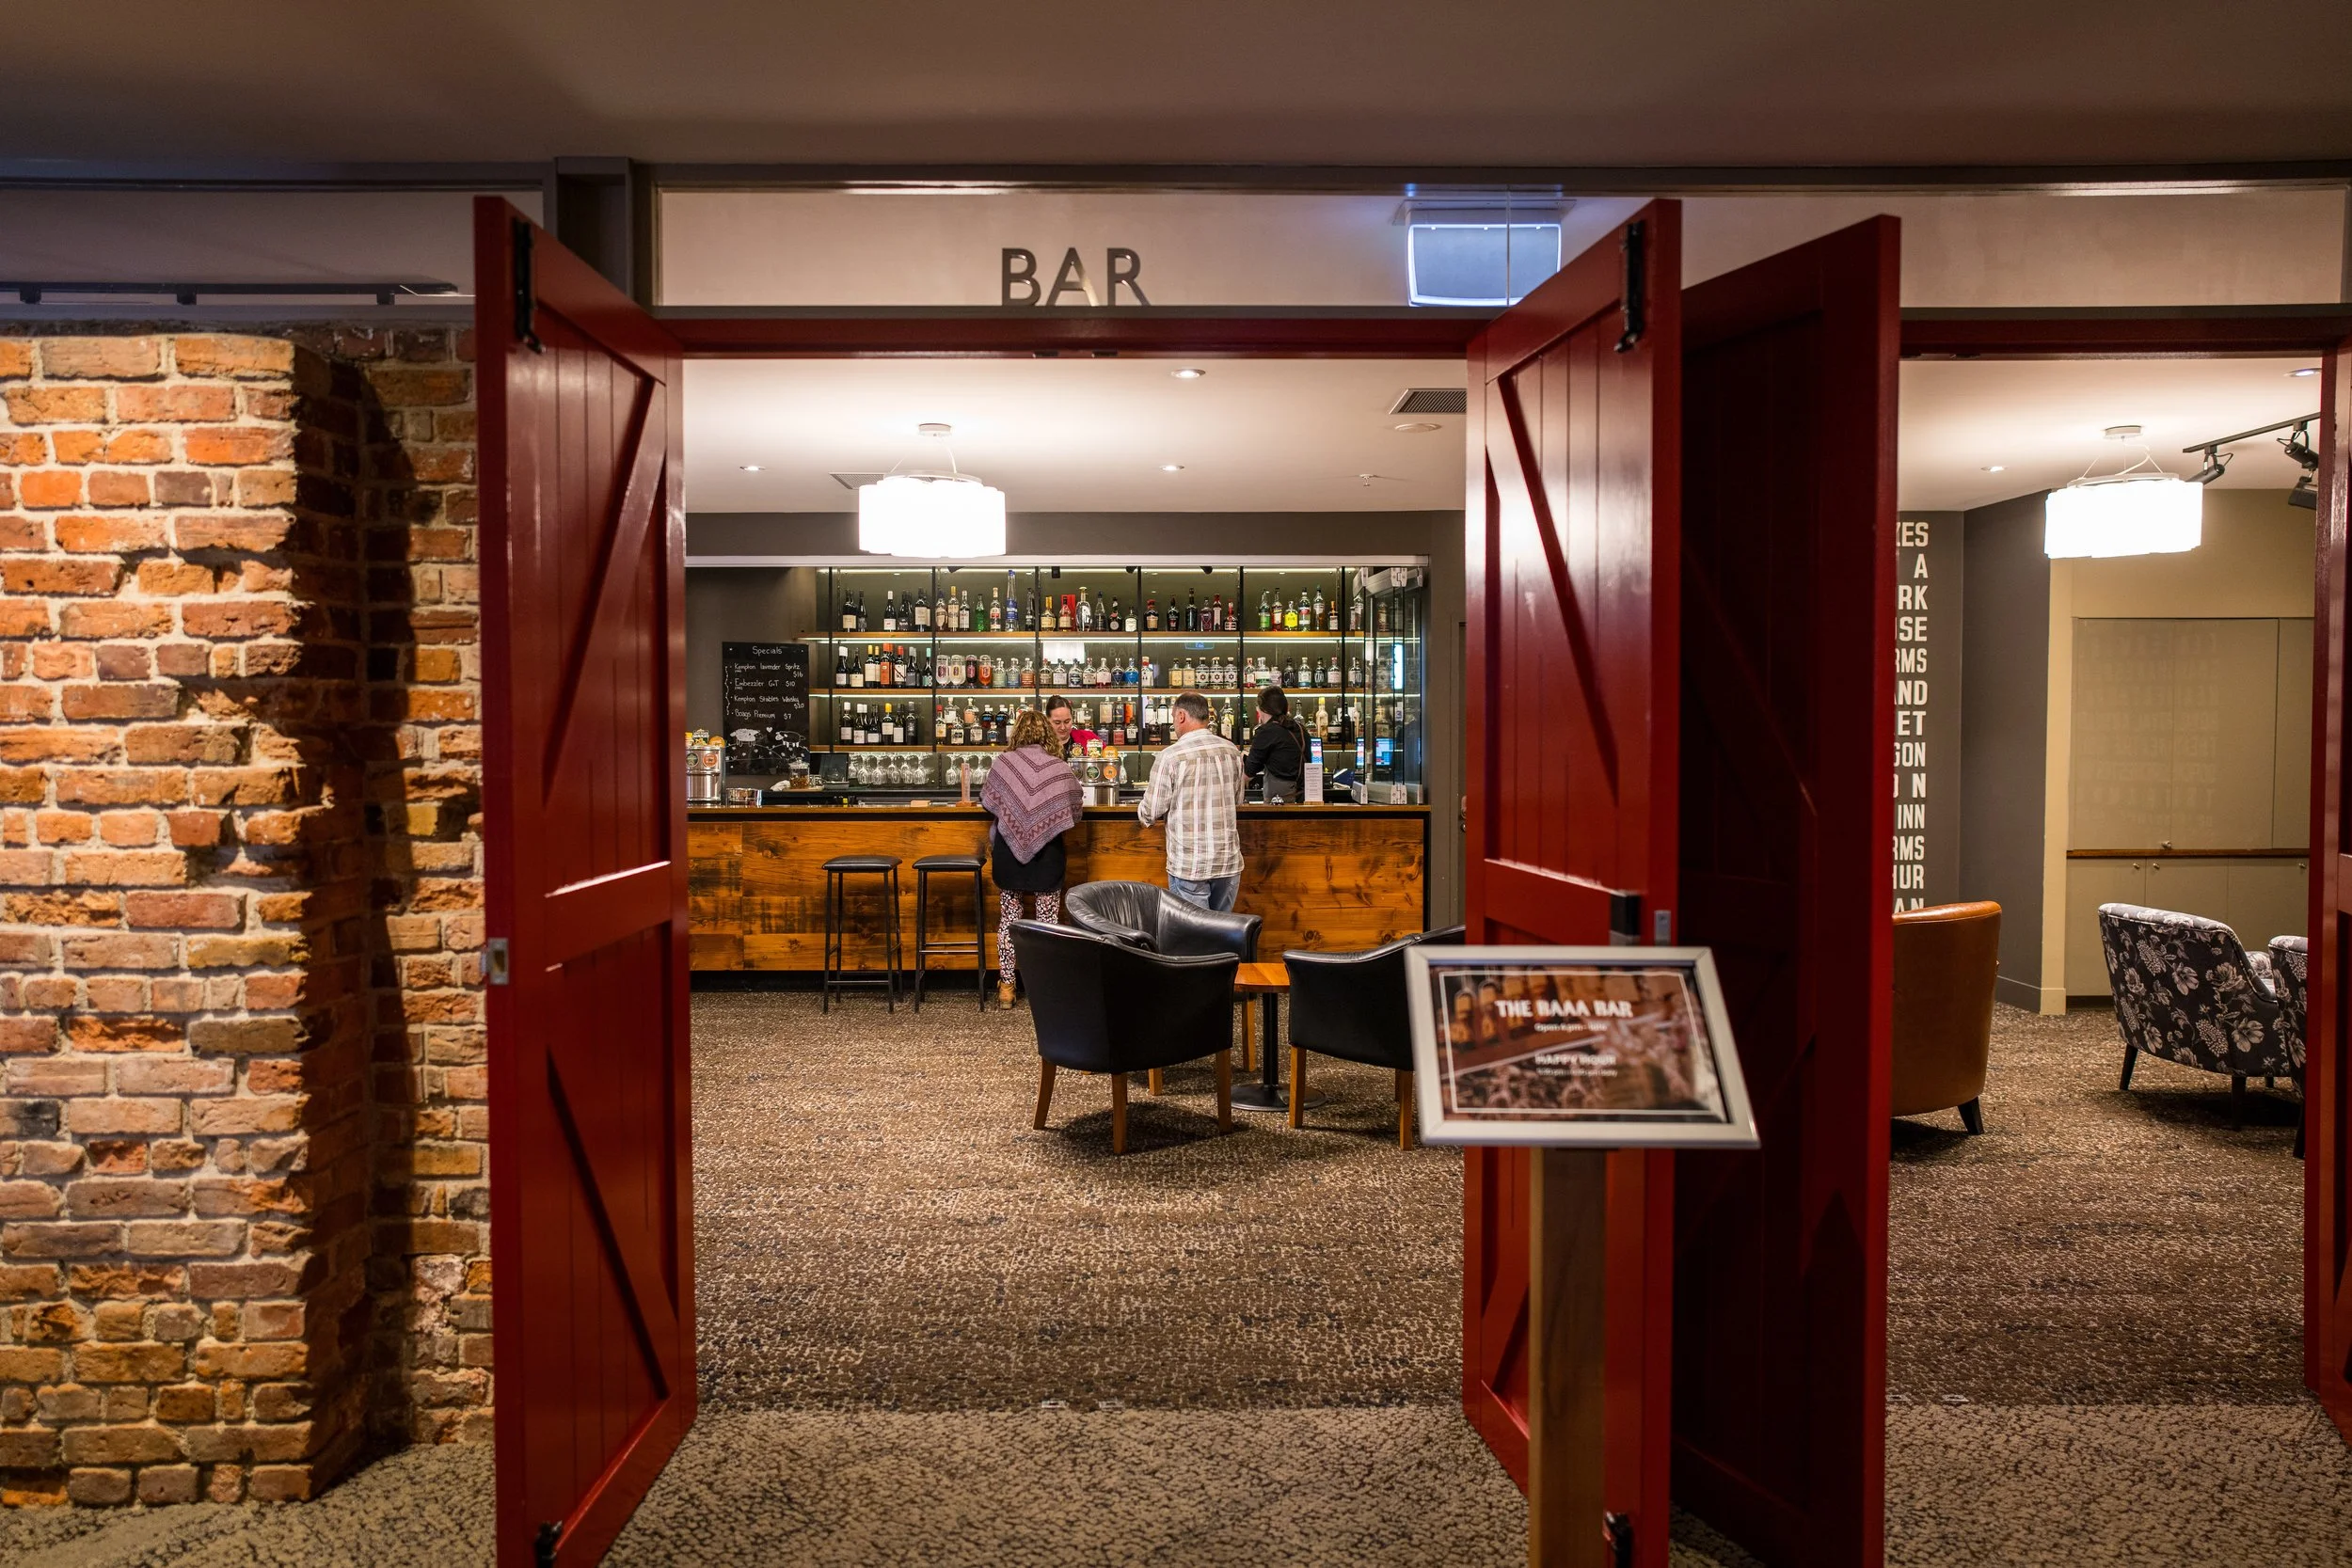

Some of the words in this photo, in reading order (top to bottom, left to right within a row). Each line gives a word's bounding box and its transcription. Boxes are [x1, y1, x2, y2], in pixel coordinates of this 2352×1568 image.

[1002, 247, 1152, 307] BAR
[1895, 616, 1928, 641] SE
[753, 645, 782, 657] Specials
[735, 663, 755, 672] Kempton
[735, 695, 755, 704] Kempton
[1894, 680, 1928, 705] ND
[754, 709, 776, 719] Premium
[1898, 804, 1925, 830] INN
[1495, 1000, 1533, 1018] THE
[1535, 1000, 1591, 1018] BAAA
[1593, 1000, 1633, 1018] BAR
[1534, 1053, 1577, 1065] HAPPY
[1579, 1053, 1616, 1065] HOUR
